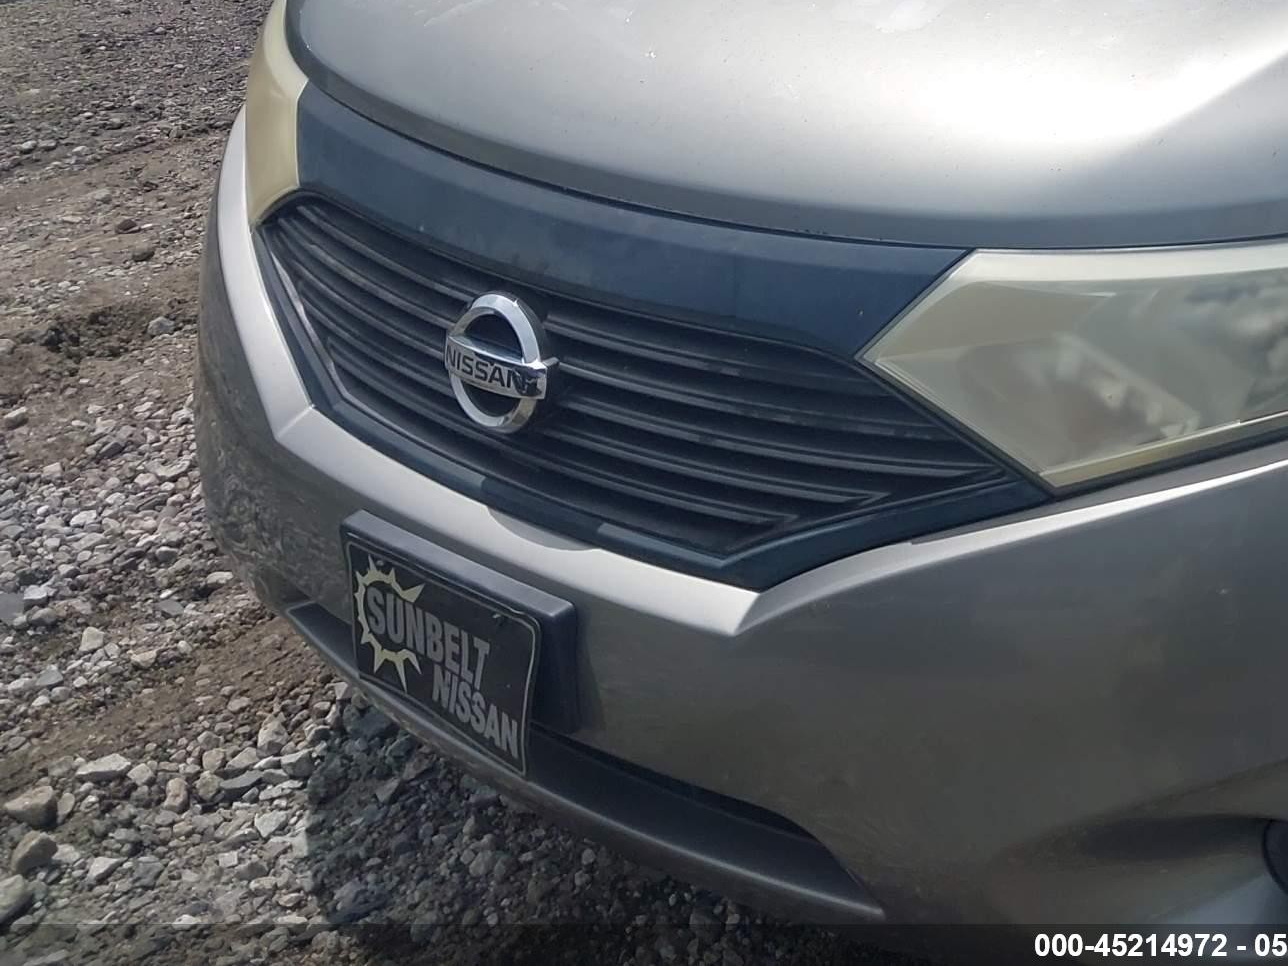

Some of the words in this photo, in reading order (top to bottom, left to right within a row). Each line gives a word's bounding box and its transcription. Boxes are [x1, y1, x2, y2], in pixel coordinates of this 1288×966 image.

[446, 344, 528, 394] NISSAN
[366, 586, 490, 690] SUNBELT
[432, 664, 519, 759] NISSAN
